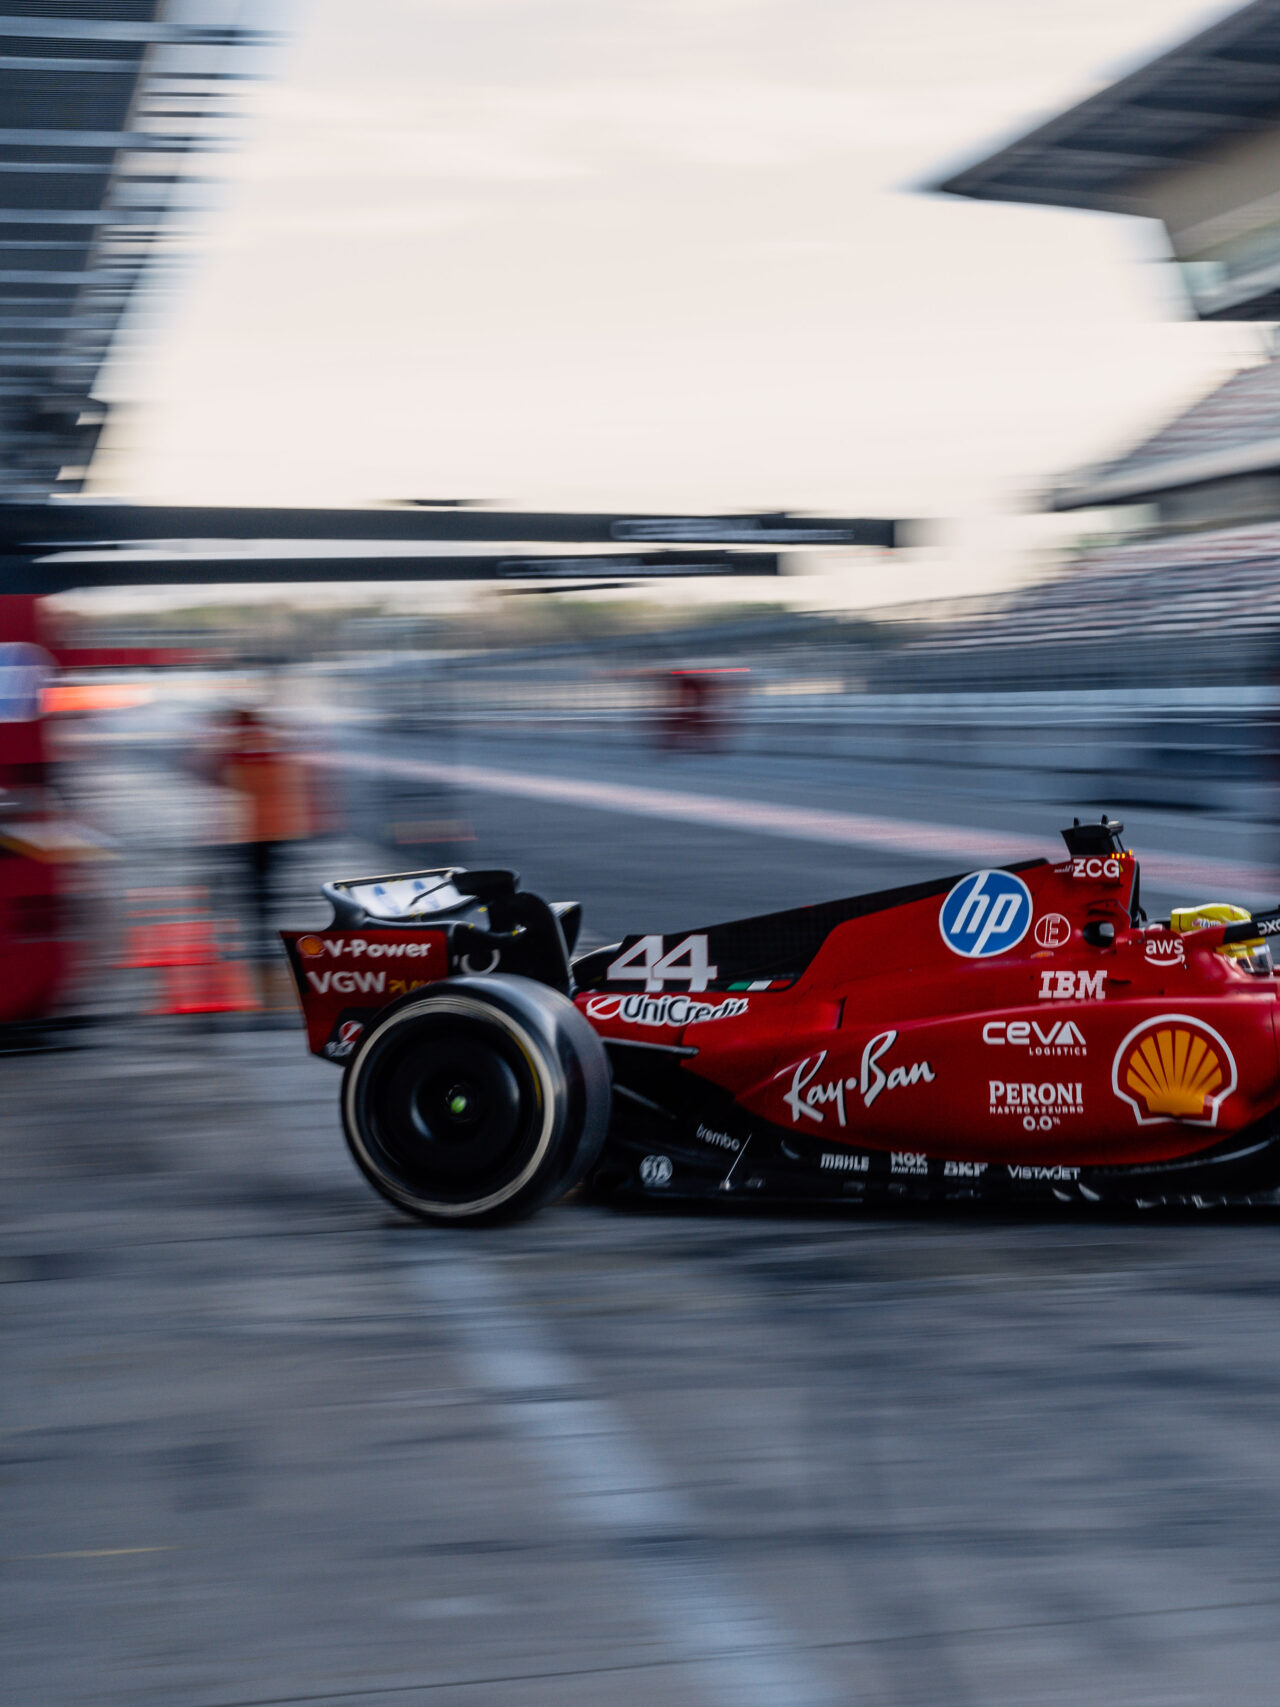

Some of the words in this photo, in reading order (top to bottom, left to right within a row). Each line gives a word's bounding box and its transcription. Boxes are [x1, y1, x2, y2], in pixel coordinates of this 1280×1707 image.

[949, 871, 1023, 956] hp
[324, 938, 432, 959] V-Power
[1145, 938, 1184, 956] aws
[606, 934, 718, 993] 44
[305, 970, 387, 995] VGW
[1038, 970, 1108, 1000] IBM
[621, 994, 749, 1026] UniCredit
[1029, 1046, 1087, 1057] LOGISTICS
[988, 1080, 1084, 1106] PERONI
[695, 1122, 741, 1152] brembo
[820, 1153, 870, 1172] MAHLE
[890, 1151, 928, 1167] NGK
